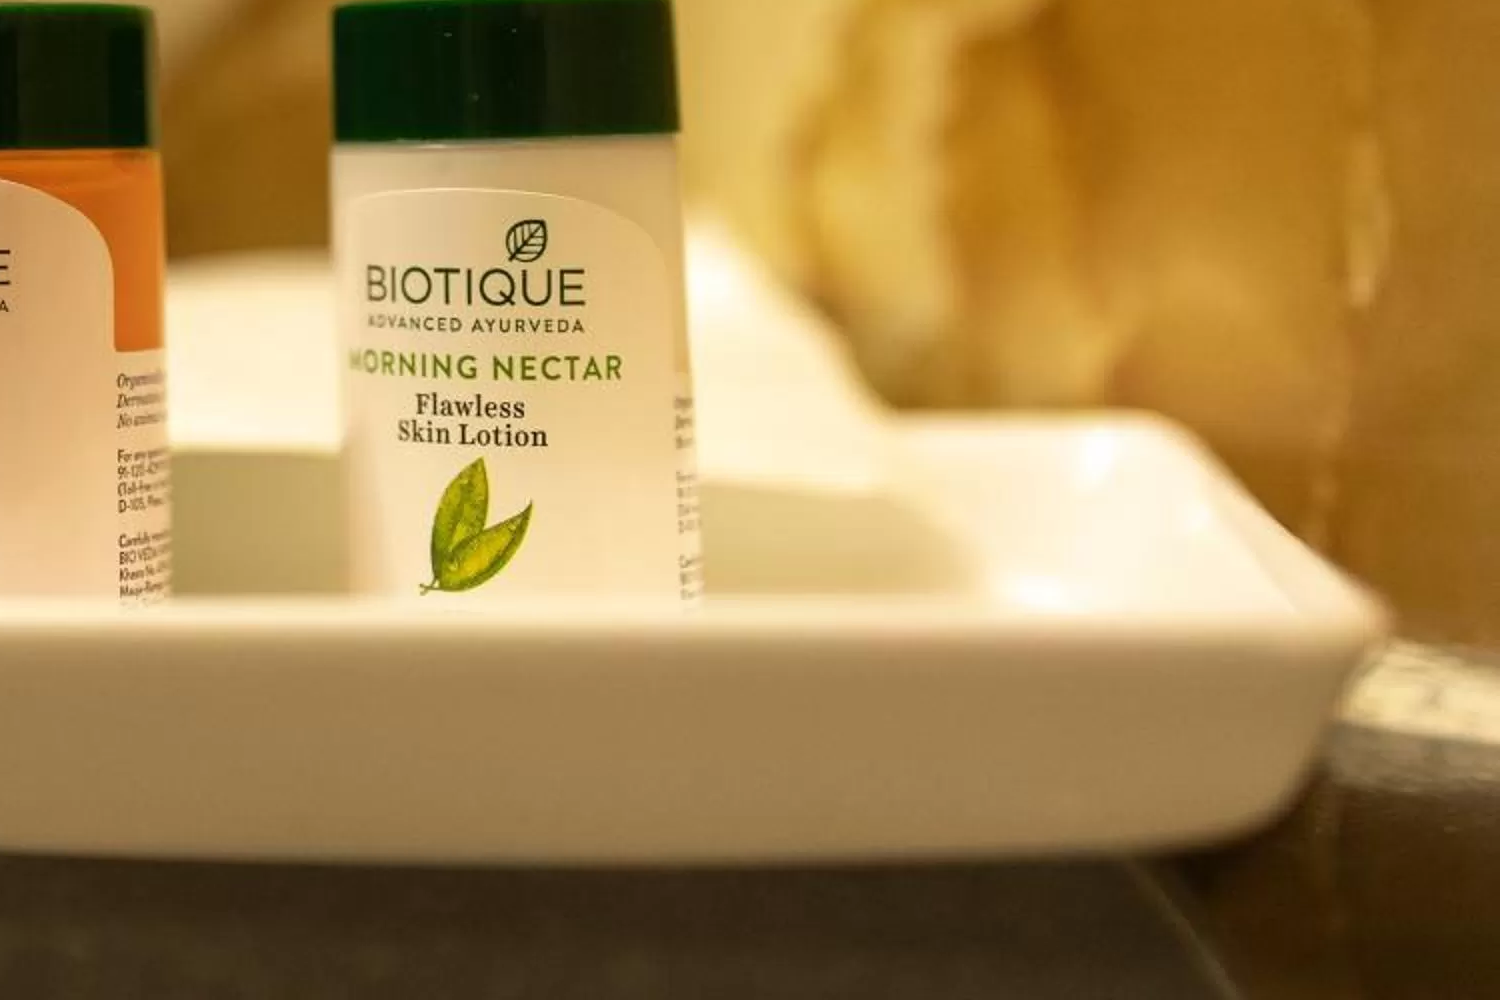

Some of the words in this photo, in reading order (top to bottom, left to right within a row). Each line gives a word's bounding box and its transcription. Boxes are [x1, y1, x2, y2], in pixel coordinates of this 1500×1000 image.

[366, 264, 586, 307] BIOTIQUE
[367, 313, 462, 333] ADVANCED
[471, 319, 586, 333] AYURVEDA
[348, 347, 478, 380] MORNING
[493, 355, 623, 381] NECTAR
[414, 393, 526, 419] Flawless
[397, 420, 452, 445] Skin
[458, 423, 548, 448] Lotion
